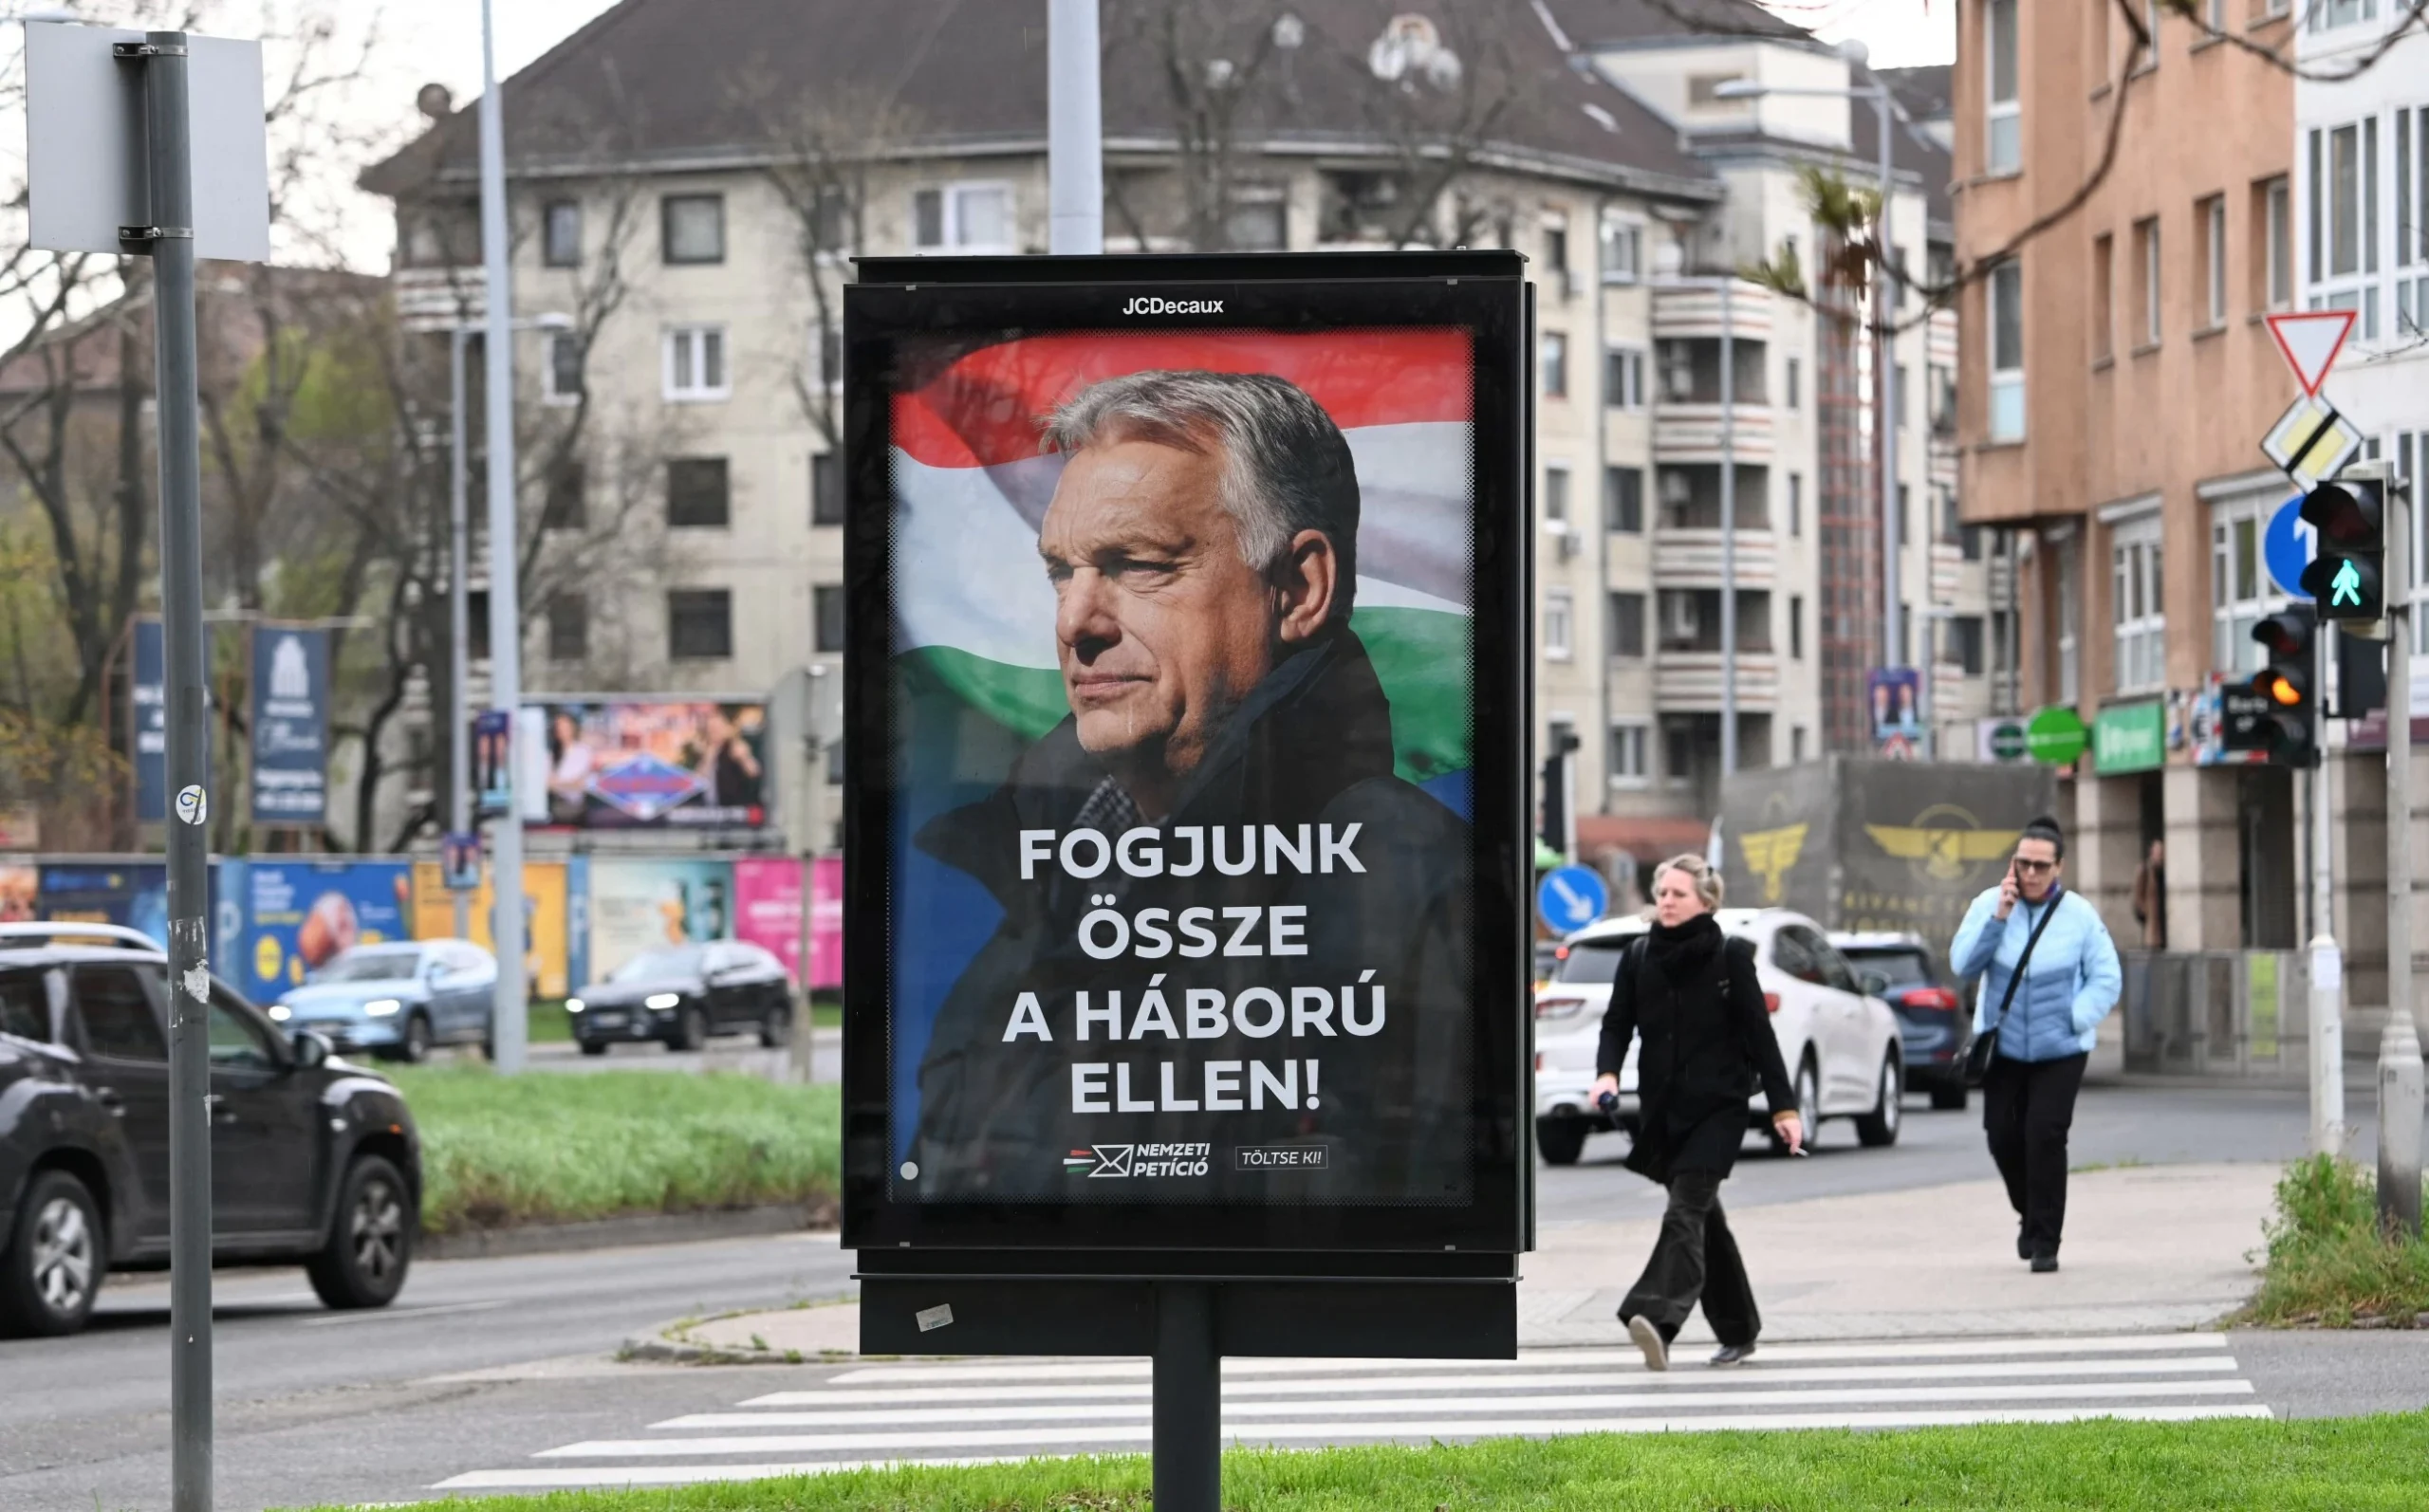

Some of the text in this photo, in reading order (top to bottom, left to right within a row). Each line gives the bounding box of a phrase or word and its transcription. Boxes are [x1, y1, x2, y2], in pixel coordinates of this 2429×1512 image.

[1122, 297, 1224, 315] JCDecaux
[1019, 822, 1367, 879] FOGJUNK
[1078, 894, 1308, 960] ÖSSZE
[1002, 968, 1385, 1042] A HÁBORÚ
[1071, 1059, 1320, 1114] ELLEN!
[1133, 1158, 1210, 1177] PETÍCIÓ
[1136, 1142, 1211, 1157] NEMZETI
[1242, 1149, 1322, 1166] TÖLTSE KI!
